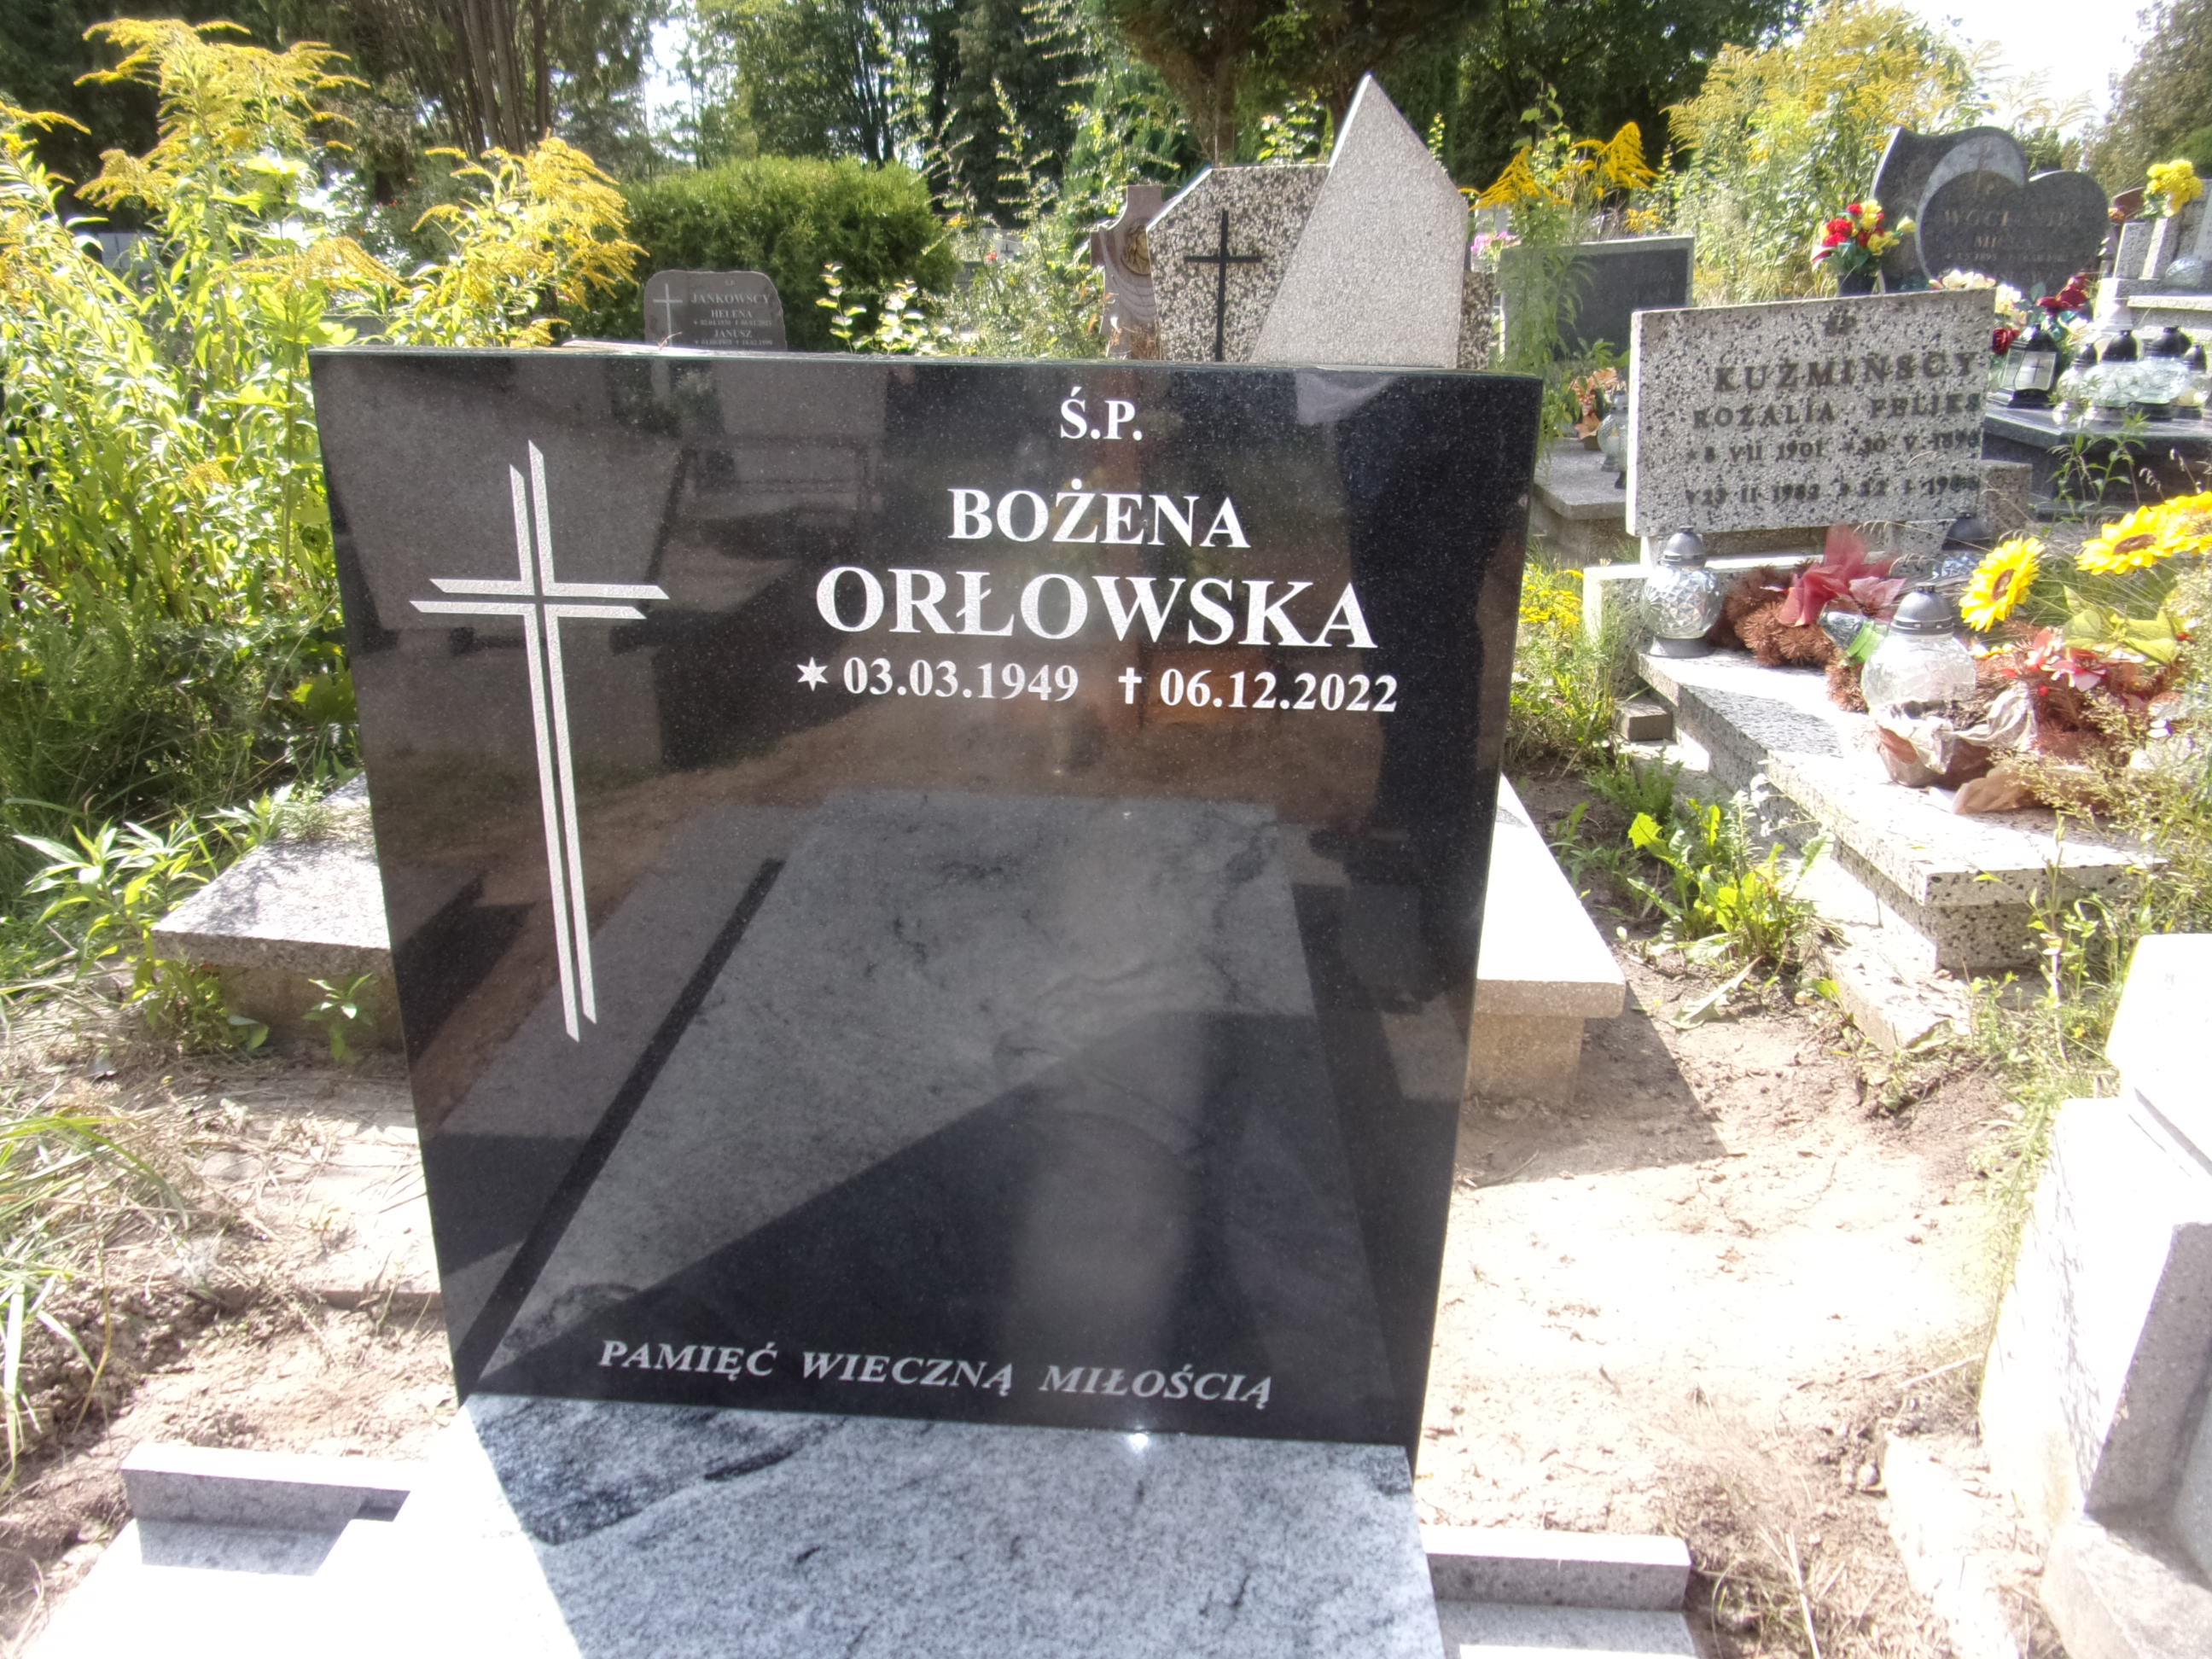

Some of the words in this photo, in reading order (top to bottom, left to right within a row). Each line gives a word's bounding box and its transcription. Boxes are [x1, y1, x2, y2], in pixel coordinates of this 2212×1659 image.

[690, 293, 770, 304] JANKOWSCY
[711, 309, 753, 318] HELENA
[714, 329, 753, 338] JANUSZ
[1060, 387, 1143, 441] Ś.P.
[947, 478, 1251, 549] BOŻENA
[816, 566, 1378, 649] ORŁOWSKA
[843, 656, 1079, 701] 03.03.1949
[1160, 668, 1397, 713] 06.12.2022
[600, 1340, 777, 1380] PAMIĘĆ
[800, 1350, 1014, 1397] WIECZNĄ
[1039, 1364, 1272, 1410] MIŁOŚCIĄ
